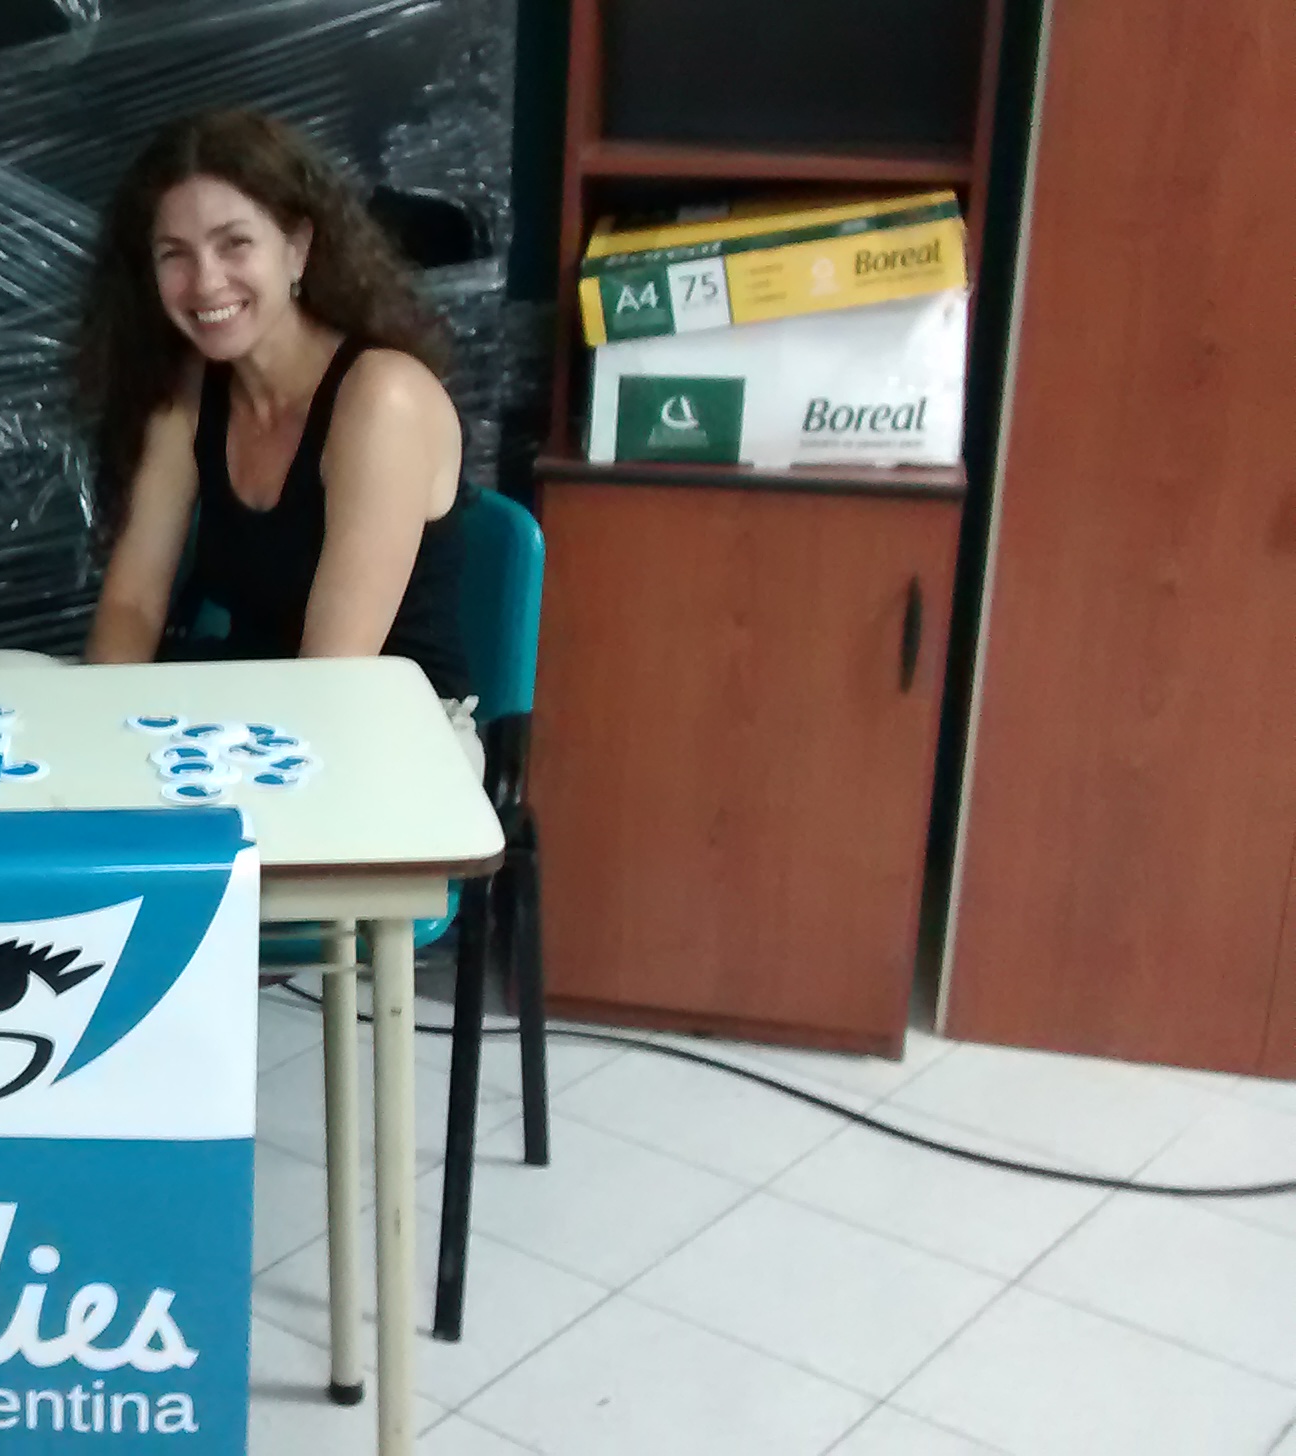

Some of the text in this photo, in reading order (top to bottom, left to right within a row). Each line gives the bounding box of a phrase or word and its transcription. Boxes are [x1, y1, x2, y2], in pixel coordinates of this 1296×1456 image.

[855, 239, 941, 275] Boreal
[616, 281, 660, 314] A4
[678, 271, 718, 302] 75
[802, 397, 928, 433] Boreal
